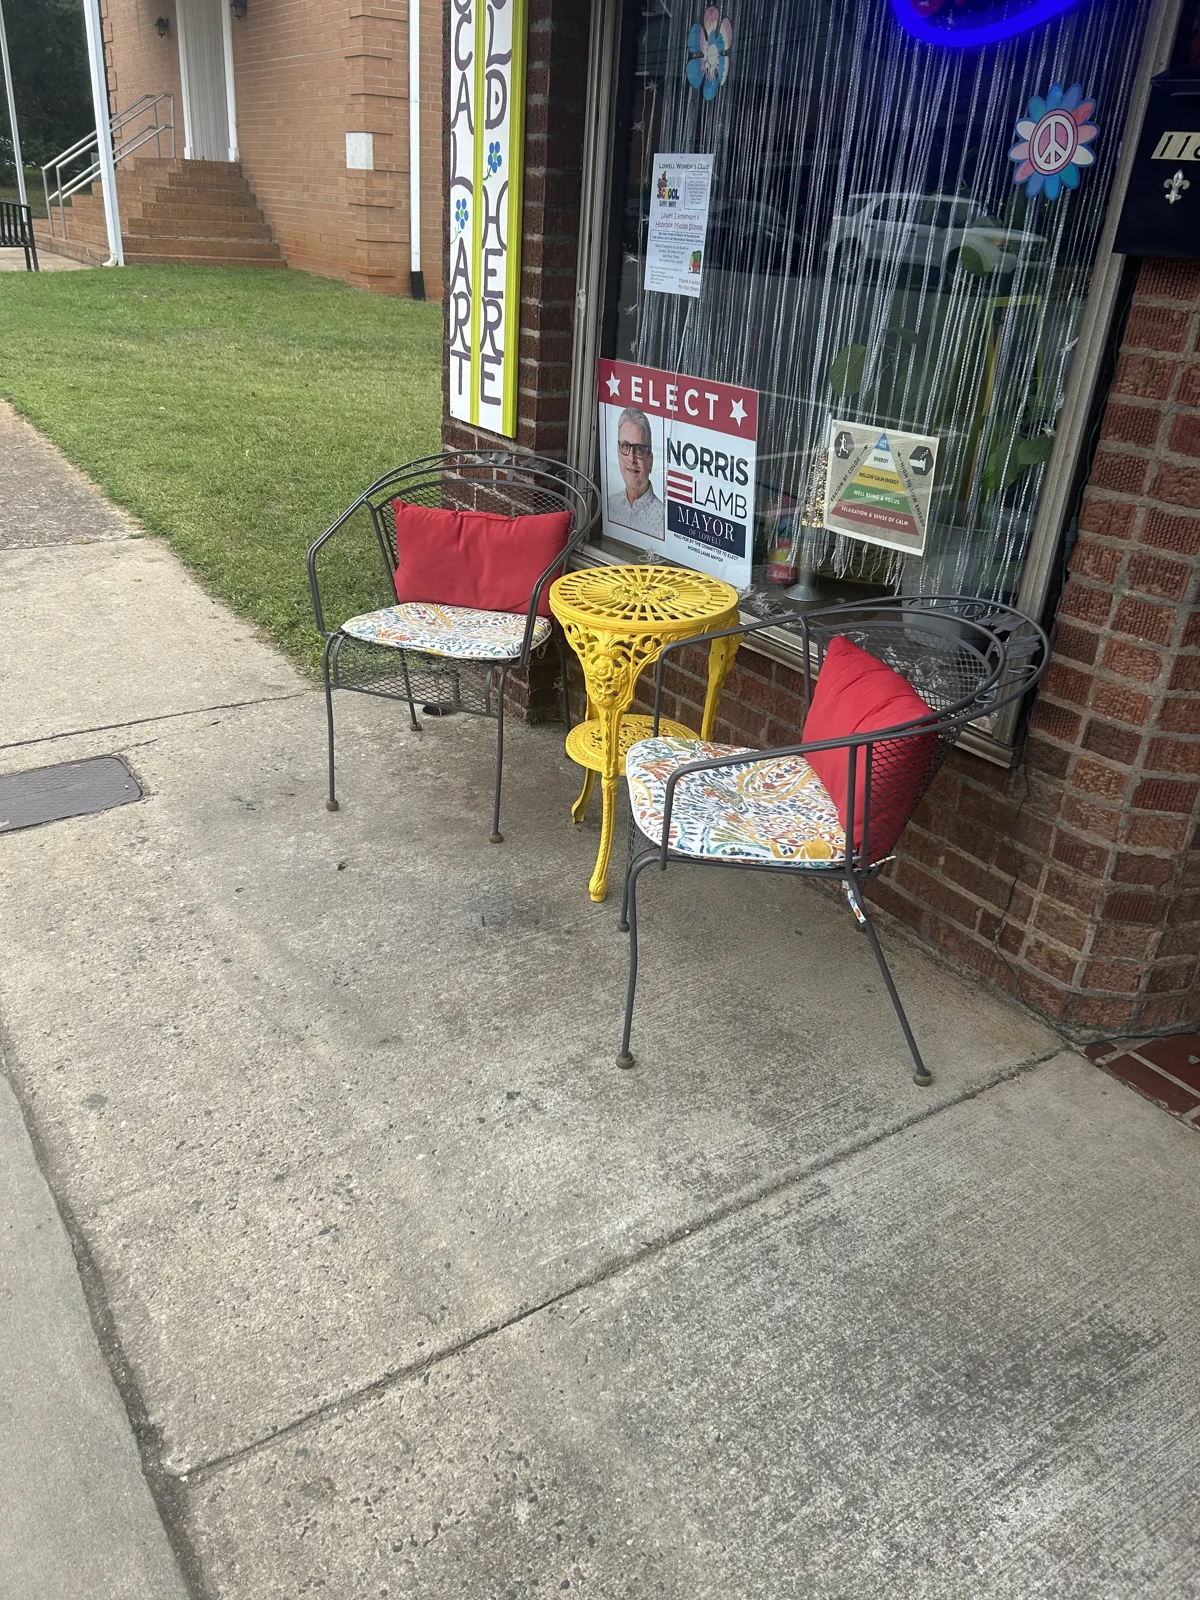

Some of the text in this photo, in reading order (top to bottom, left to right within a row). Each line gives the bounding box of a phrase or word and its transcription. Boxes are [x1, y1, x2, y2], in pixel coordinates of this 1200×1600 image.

[480, 0, 512, 406] LD HERE
[450, 237, 472, 395] ART
[631, 376, 719, 421] ELECT
[667, 438, 749, 486] NORRIS
[842, 473, 849, 482] BY
[847, 456, 861, 475] COLOR
[694, 481, 747, 519] LAMB
[853, 489, 865, 497] WELL
[865, 492, 880, 501] BEING
[884, 496, 900, 505] FOCUS
[900, 461, 925, 527] HIGH TO LOW ENERGY
[678, 506, 735, 541] MAYOR
[841, 505, 868, 517] RELAXATION
[873, 512, 888, 522] SENSE
[895, 518, 909, 526] CALM
[688, 528, 722, 546] OF LOWELL
[727, 553, 739, 561] ELECT
